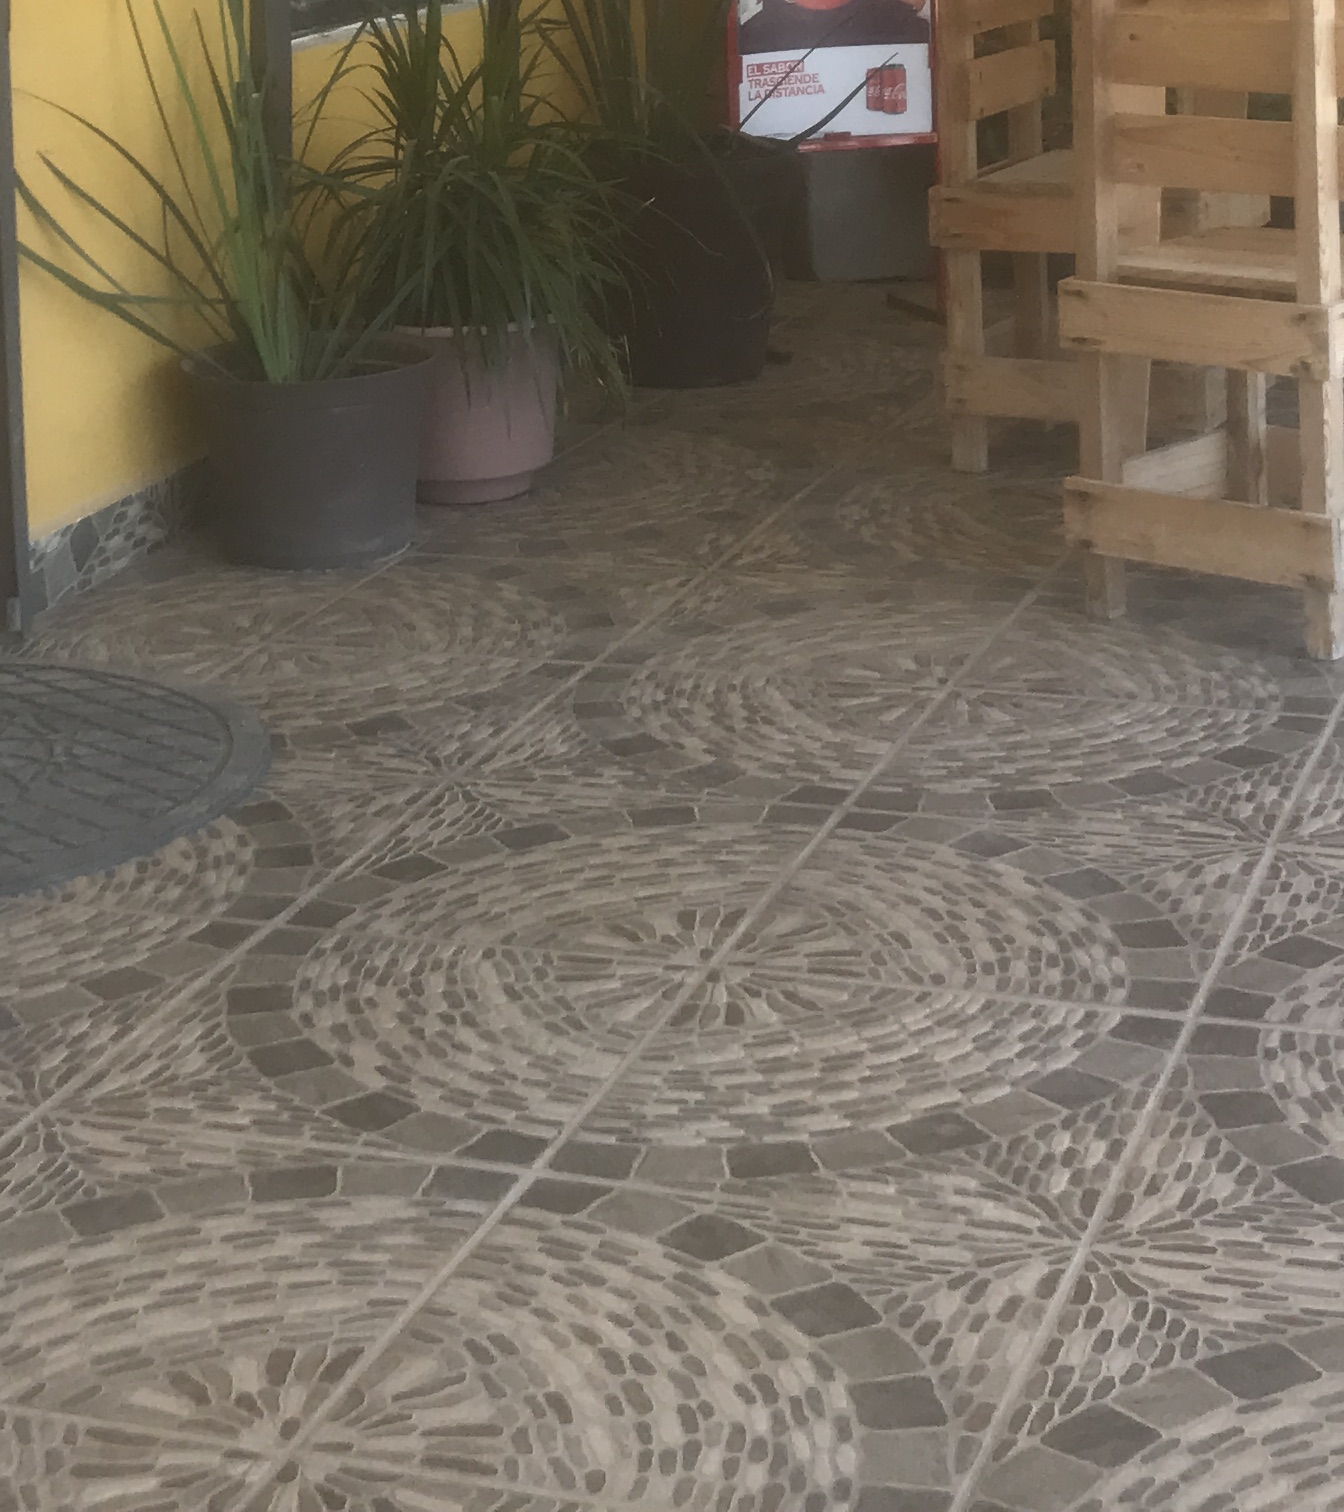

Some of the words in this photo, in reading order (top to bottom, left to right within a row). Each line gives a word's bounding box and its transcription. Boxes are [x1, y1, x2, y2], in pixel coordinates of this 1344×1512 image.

[748, 64, 761, 76] EL
[748, 74, 819, 89] TRASCIENDE
[748, 91, 763, 101] LA
